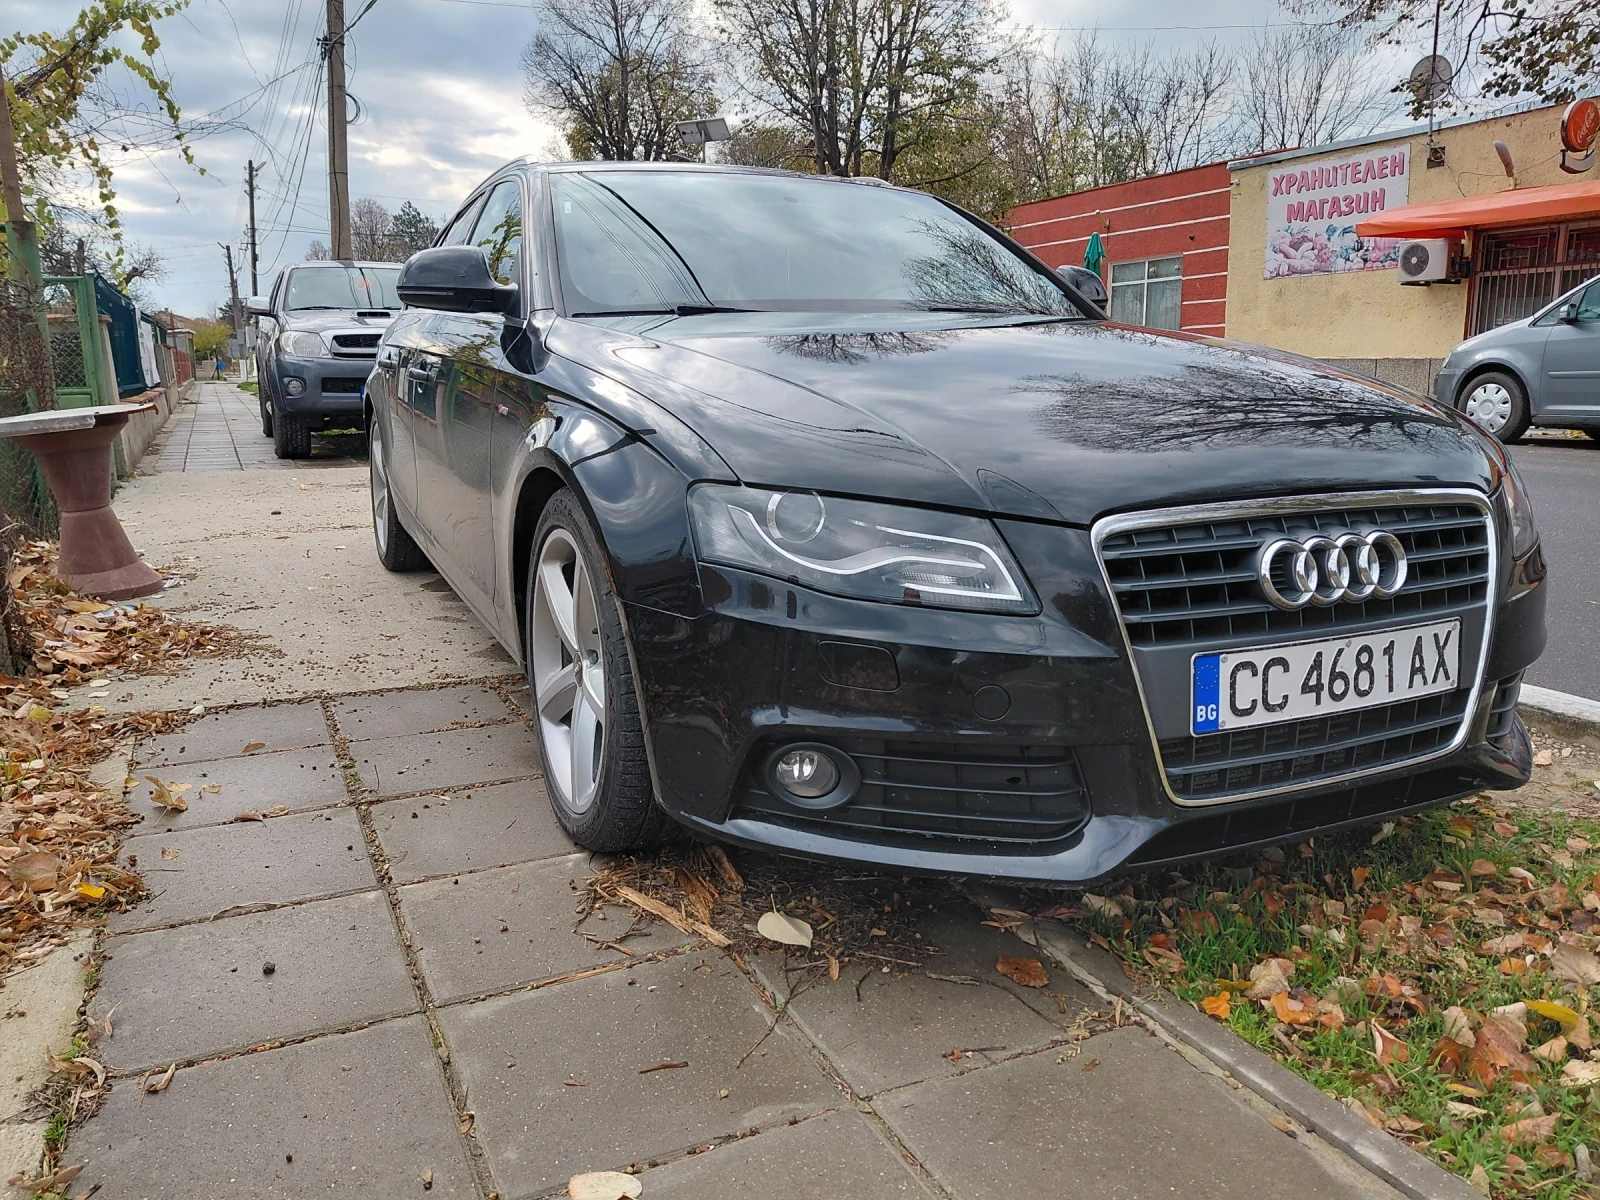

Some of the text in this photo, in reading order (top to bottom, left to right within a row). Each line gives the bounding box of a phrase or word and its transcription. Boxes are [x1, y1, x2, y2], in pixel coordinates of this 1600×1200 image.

[1272, 152, 1405, 197] ХРАНИТЕЛЕН
[1286, 187, 1386, 224] МАГАЗИН
[1229, 629, 1453, 717] CC 4681 AX
[1196, 704, 1217, 723] BG
